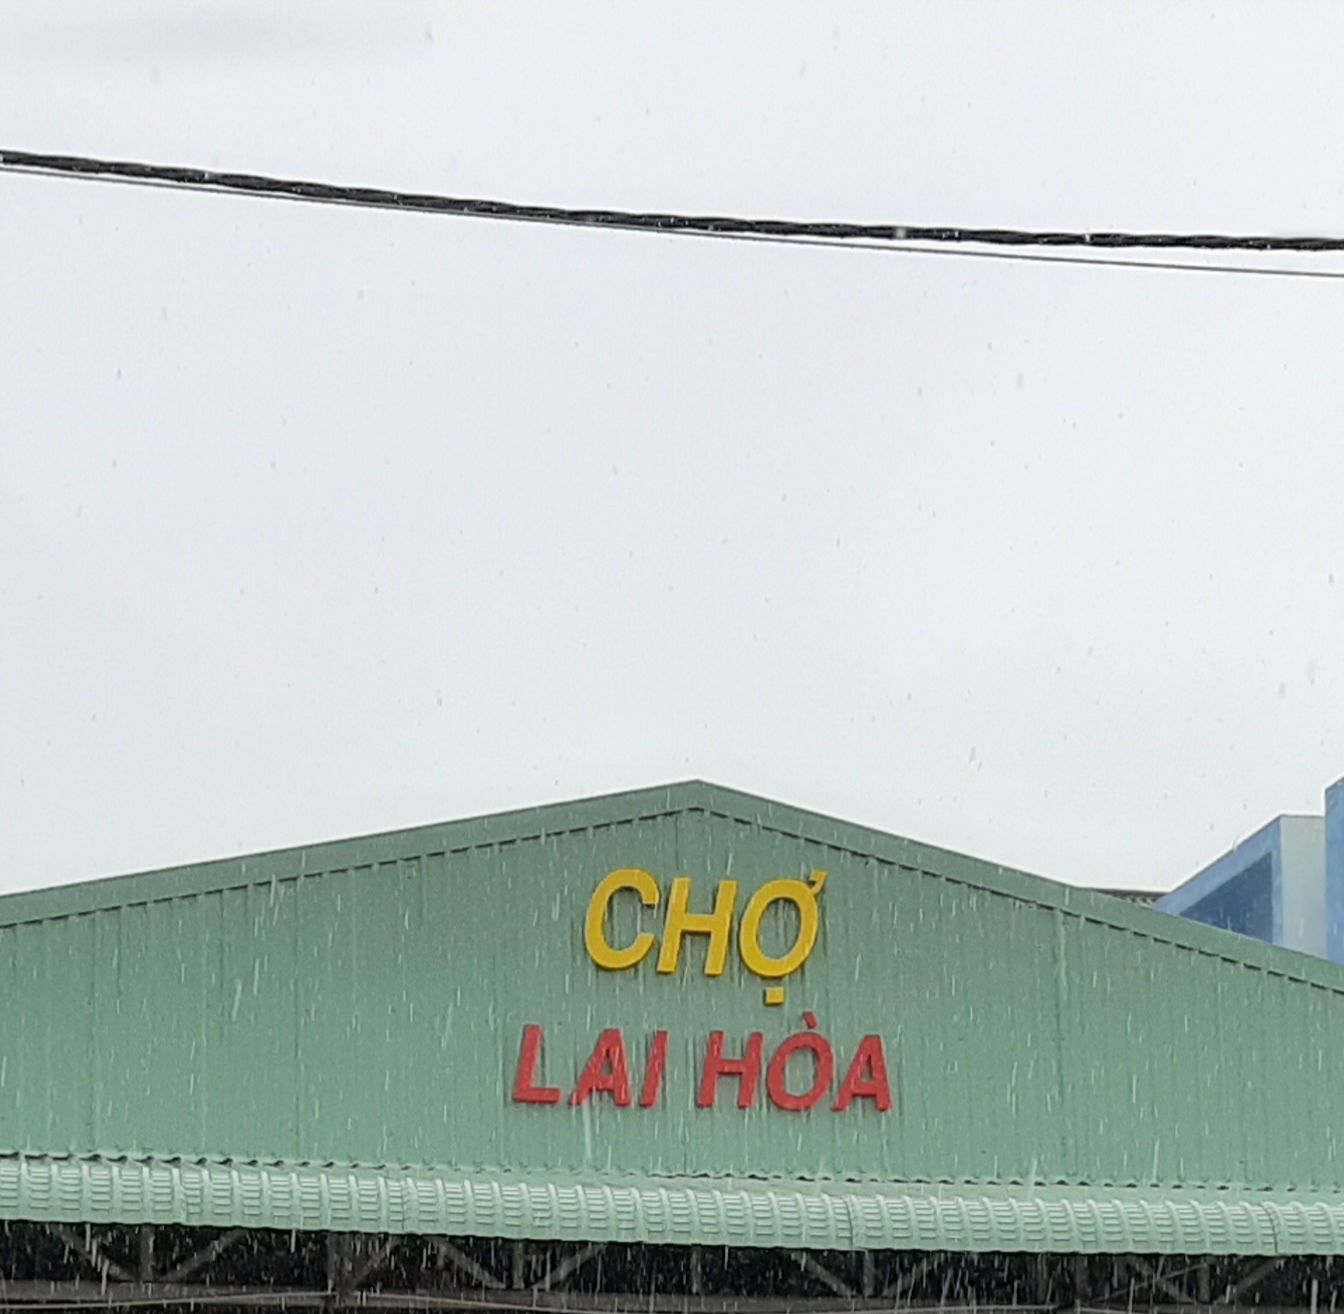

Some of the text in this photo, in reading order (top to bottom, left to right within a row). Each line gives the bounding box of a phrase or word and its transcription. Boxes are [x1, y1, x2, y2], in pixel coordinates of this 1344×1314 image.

[585, 868, 827, 1005] CHỢ
[513, 1011, 893, 1112] LAI HÒA
